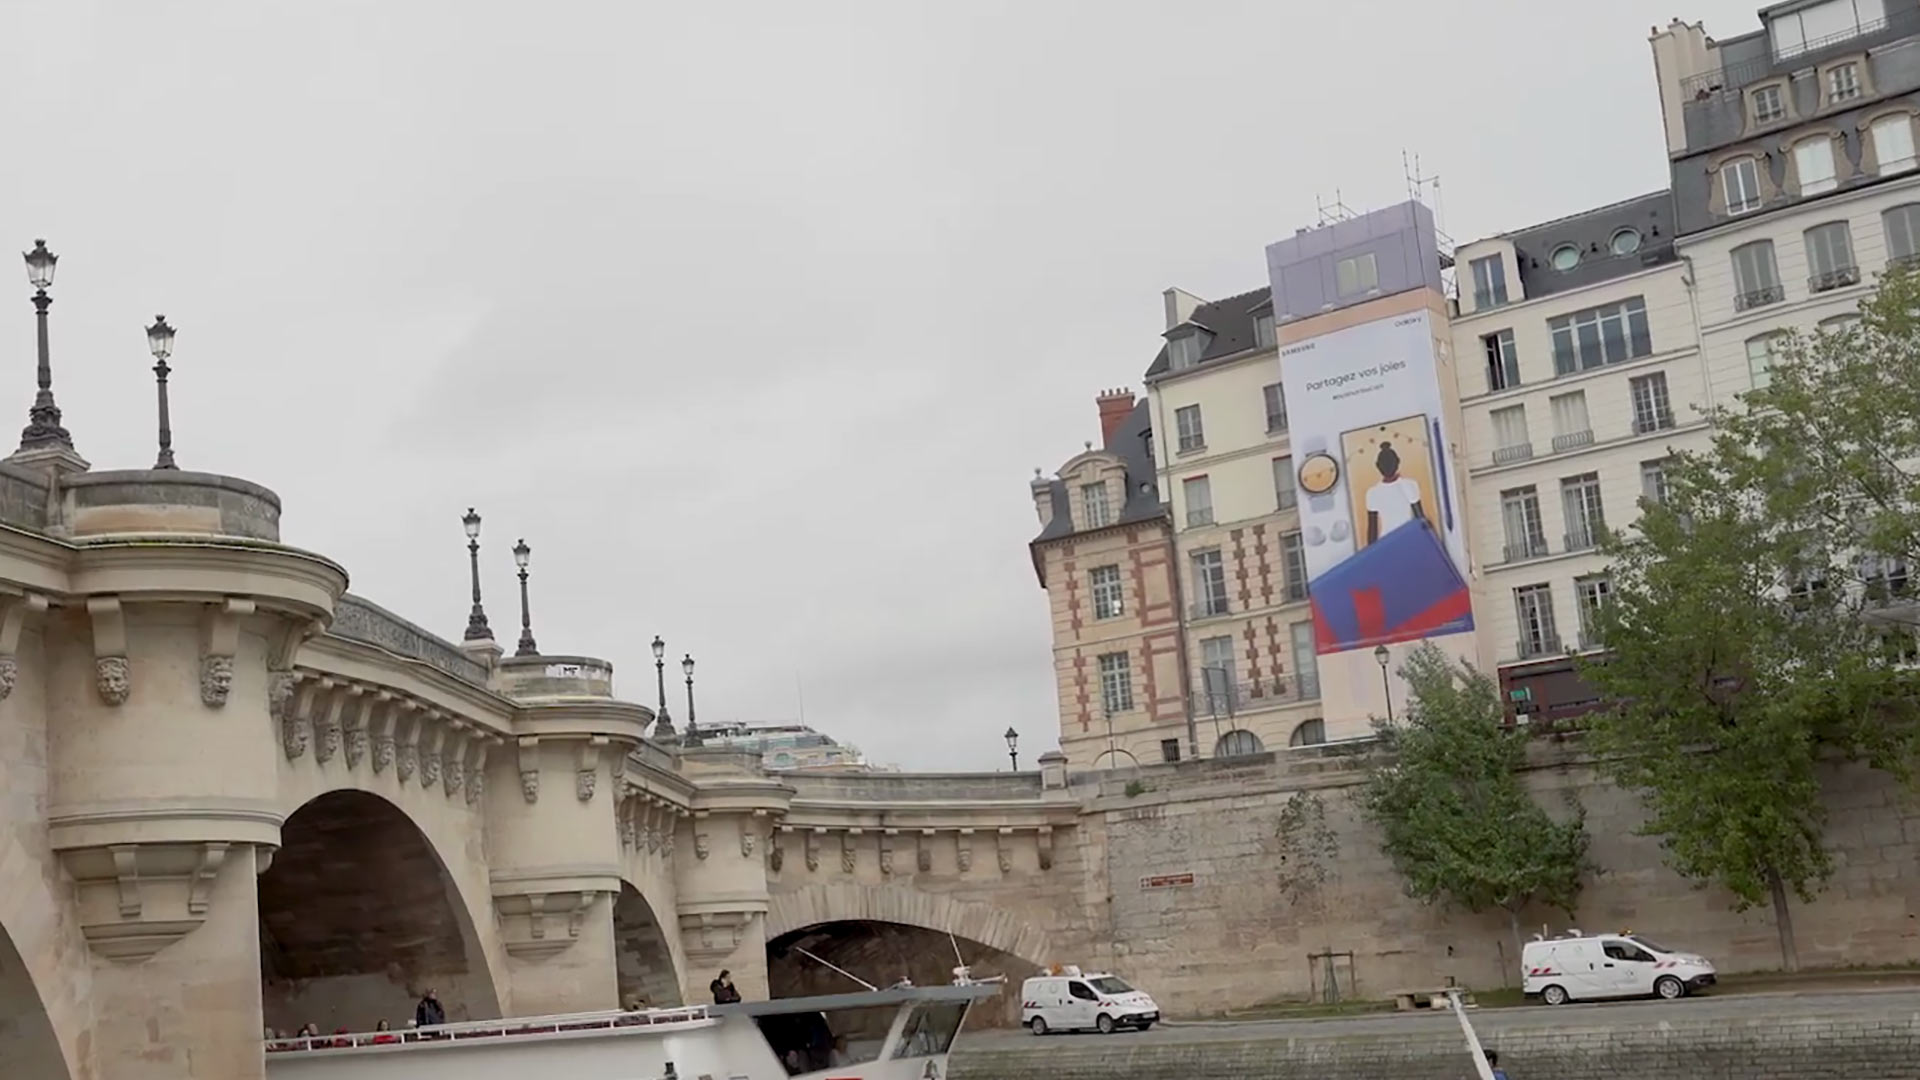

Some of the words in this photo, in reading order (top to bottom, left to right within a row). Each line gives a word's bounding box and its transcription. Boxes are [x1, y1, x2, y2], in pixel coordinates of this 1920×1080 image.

[1306, 372, 1356, 392] Partagez
[1359, 366, 1378, 379] vos
[1379, 359, 1406, 376] joies
